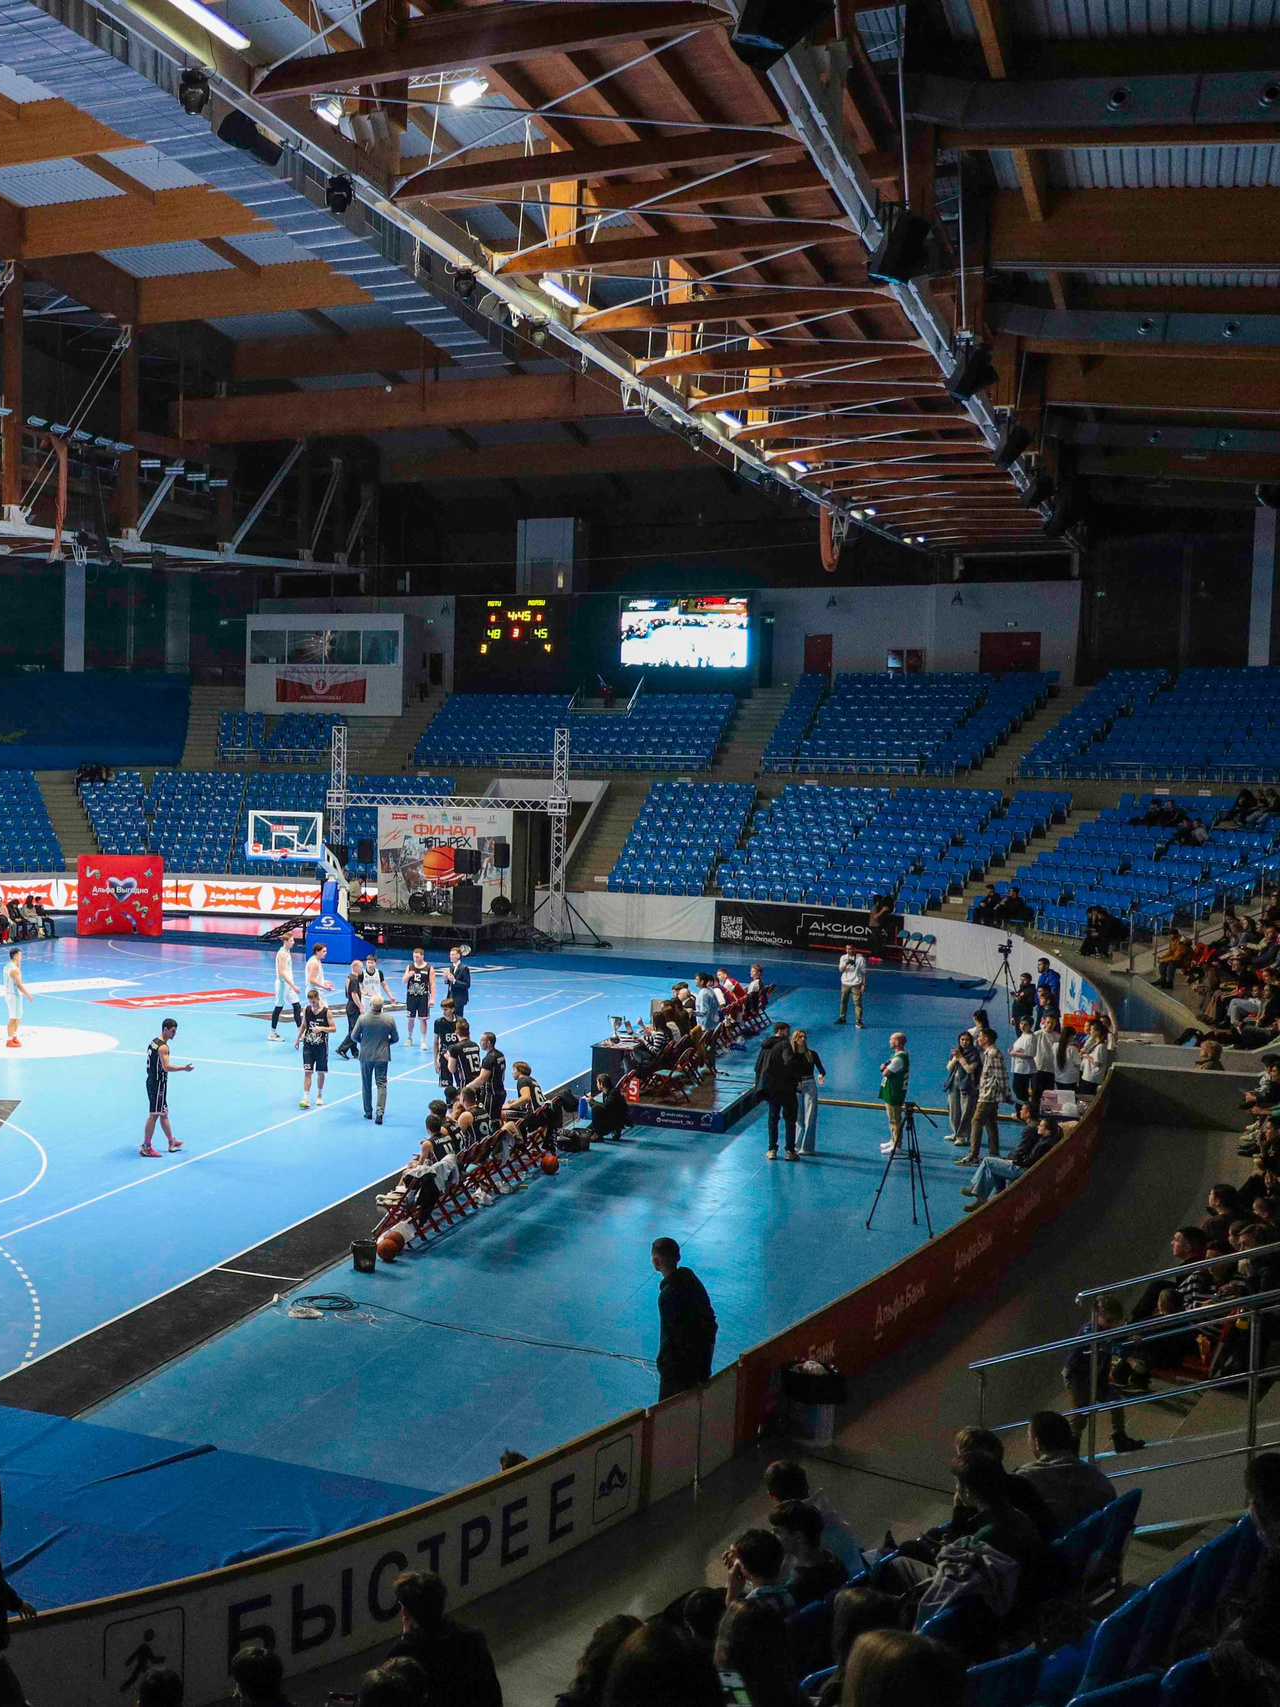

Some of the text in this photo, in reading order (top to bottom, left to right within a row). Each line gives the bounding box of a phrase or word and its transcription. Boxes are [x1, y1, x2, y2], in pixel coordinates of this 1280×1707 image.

[487, 628, 548, 639] 48 3 45
[480, 643, 551, 653] 3 4
[413, 823, 477, 837] ФИНАЛ
[419, 836, 472, 849] ЧЕТЫРЕХ
[92, 886, 148, 895] Альфа Выгодно
[209, 892, 255, 902] Альфа Банк
[278, 894, 321, 904] Альфа Бан
[744, 935, 793, 945] axioma30.ru
[414, 973, 422, 981] 12
[445, 1033, 457, 1041] 66
[629, 1080, 638, 1095] 5
[906, 1278, 927, 1308] Банк
[808, 1338, 836, 1362] Банк
